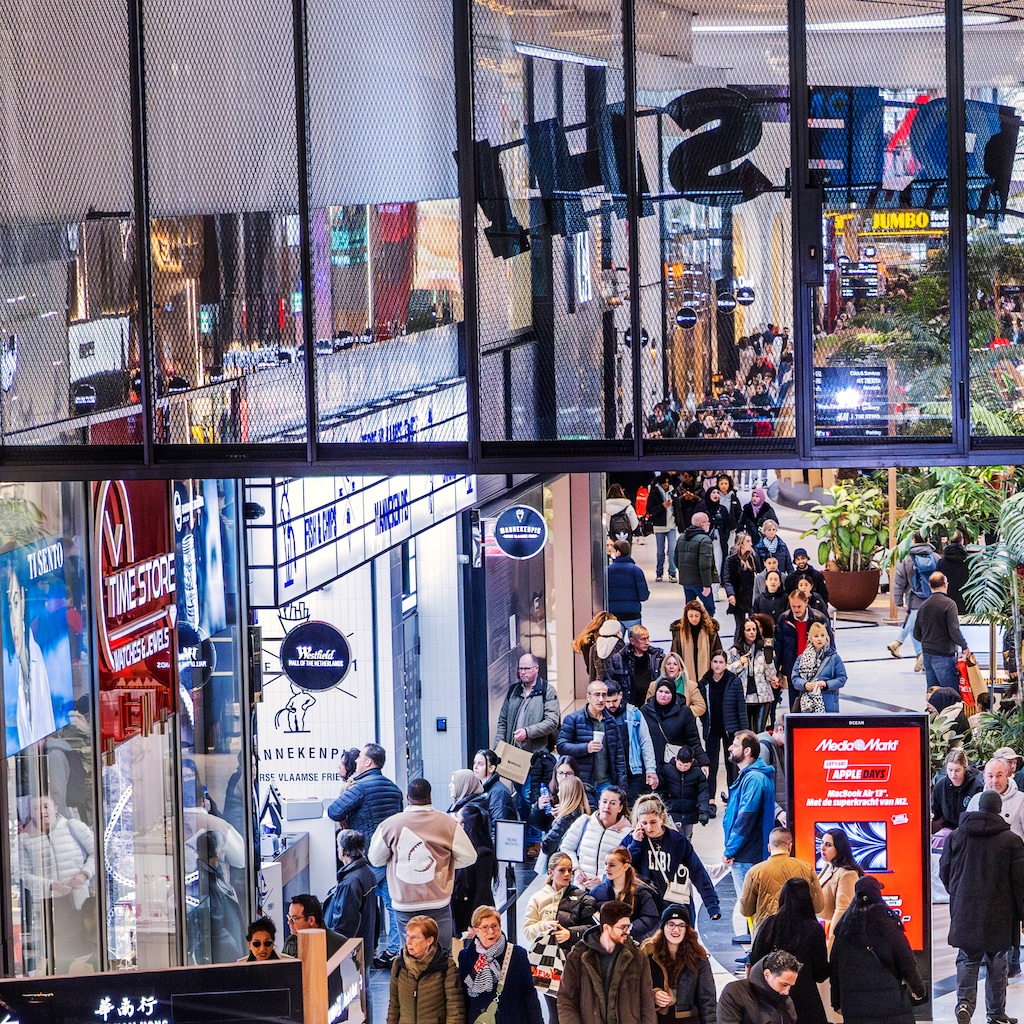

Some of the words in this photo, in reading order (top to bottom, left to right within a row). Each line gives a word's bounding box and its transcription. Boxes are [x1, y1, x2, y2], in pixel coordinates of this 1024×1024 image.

[872, 211, 929, 229] JUMBO
[304, 511, 318, 550] FISH
[322, 505, 337, 542] CHIPS
[28, 553, 37, 579] TI
[38, 542, 64, 576] SENTO
[108, 568, 137, 618] TIME
[138, 552, 176, 602] STORE
[113, 638, 142, 673] WATCHES
[145, 626, 170, 658] JEWELS
[296, 646, 336, 660] Westfield
[278, 773, 319, 782] VLAAMSE
[832, 769, 862, 779] APPLE
[863, 769, 885, 779] DAYS
[827, 789, 862, 798] MacBook
[862, 789, 874, 798] Air
[806, 799, 822, 807] Met
[831, 798, 879, 808] superkracht
[95, 995, 158, 1021] 華南行
